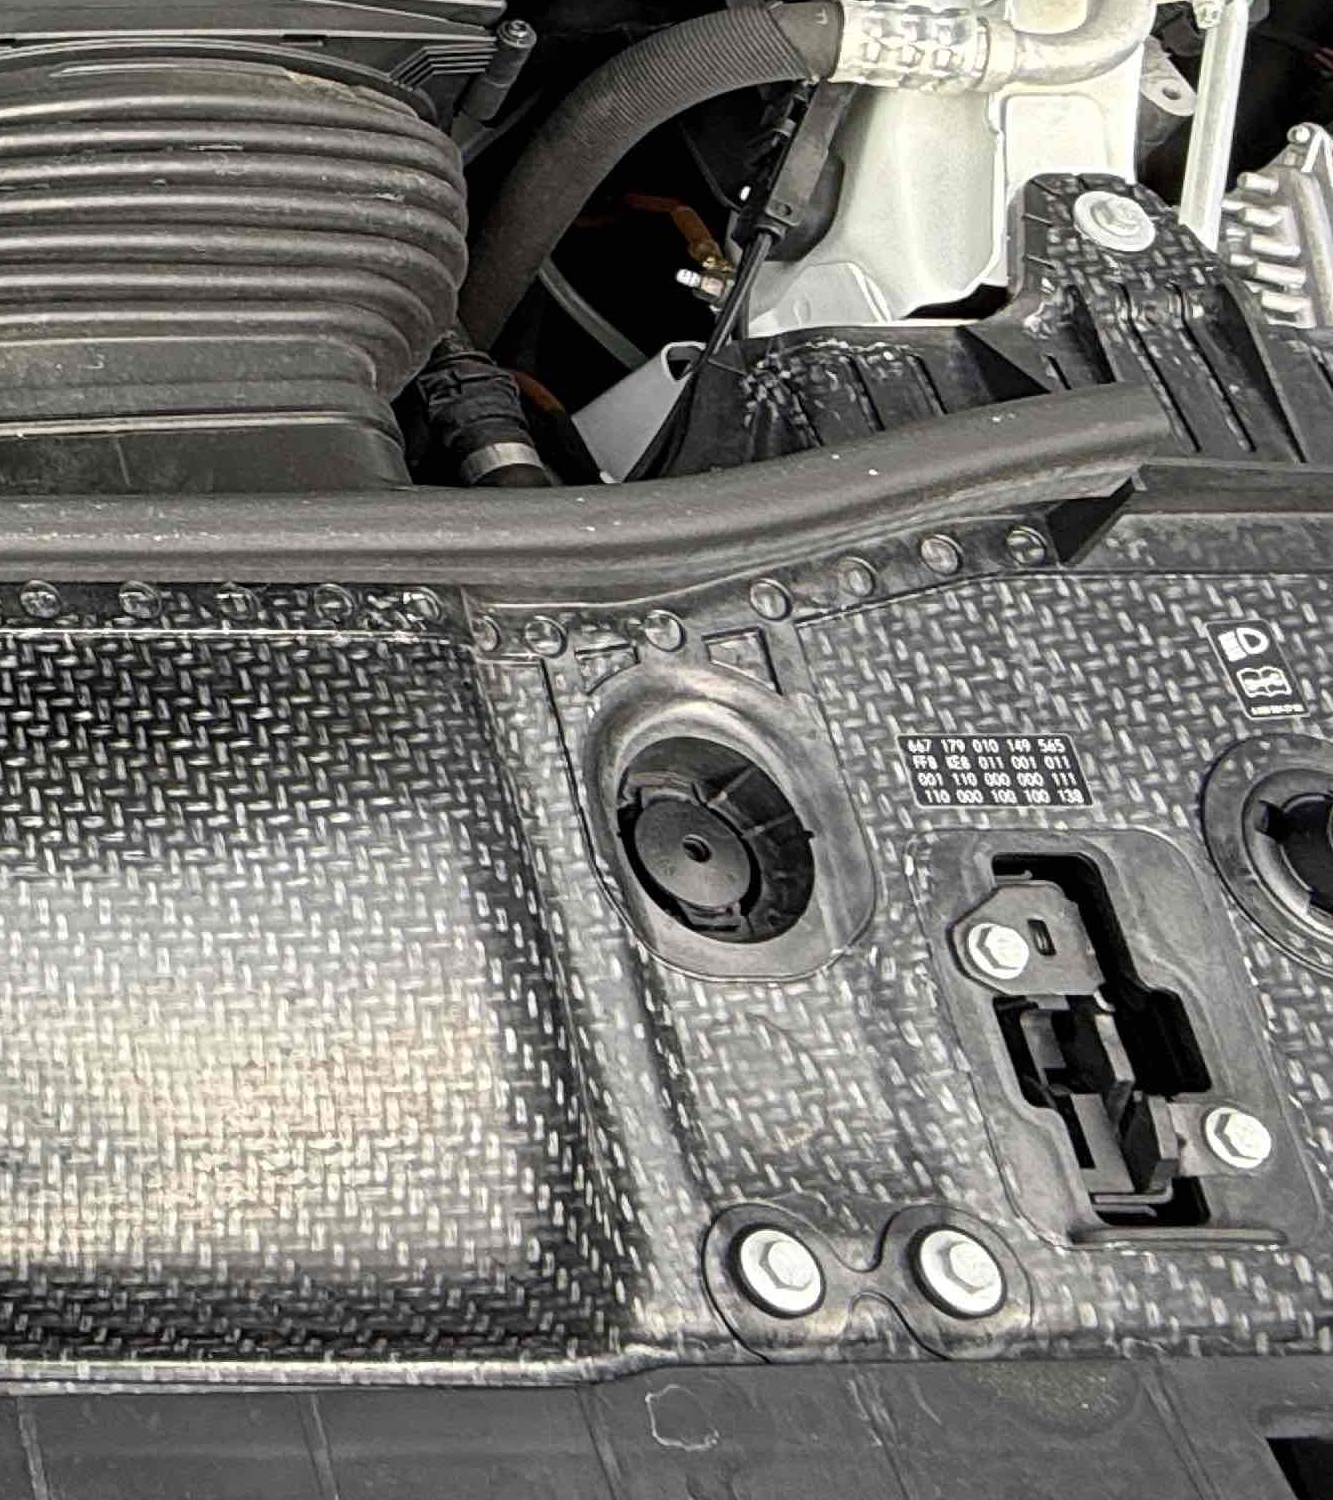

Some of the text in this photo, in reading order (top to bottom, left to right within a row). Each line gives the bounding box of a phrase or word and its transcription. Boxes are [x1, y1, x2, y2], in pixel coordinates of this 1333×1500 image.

[973, 739, 999, 753] 010
[978, 755, 1004, 770] 011
[1011, 755, 1037, 770] 001
[1044, 755, 1071, 770] 011
[952, 772, 978, 787] 110
[1052, 772, 1077, 787] 111
[925, 789, 951, 804] 110
[956, 789, 984, 804] 000
